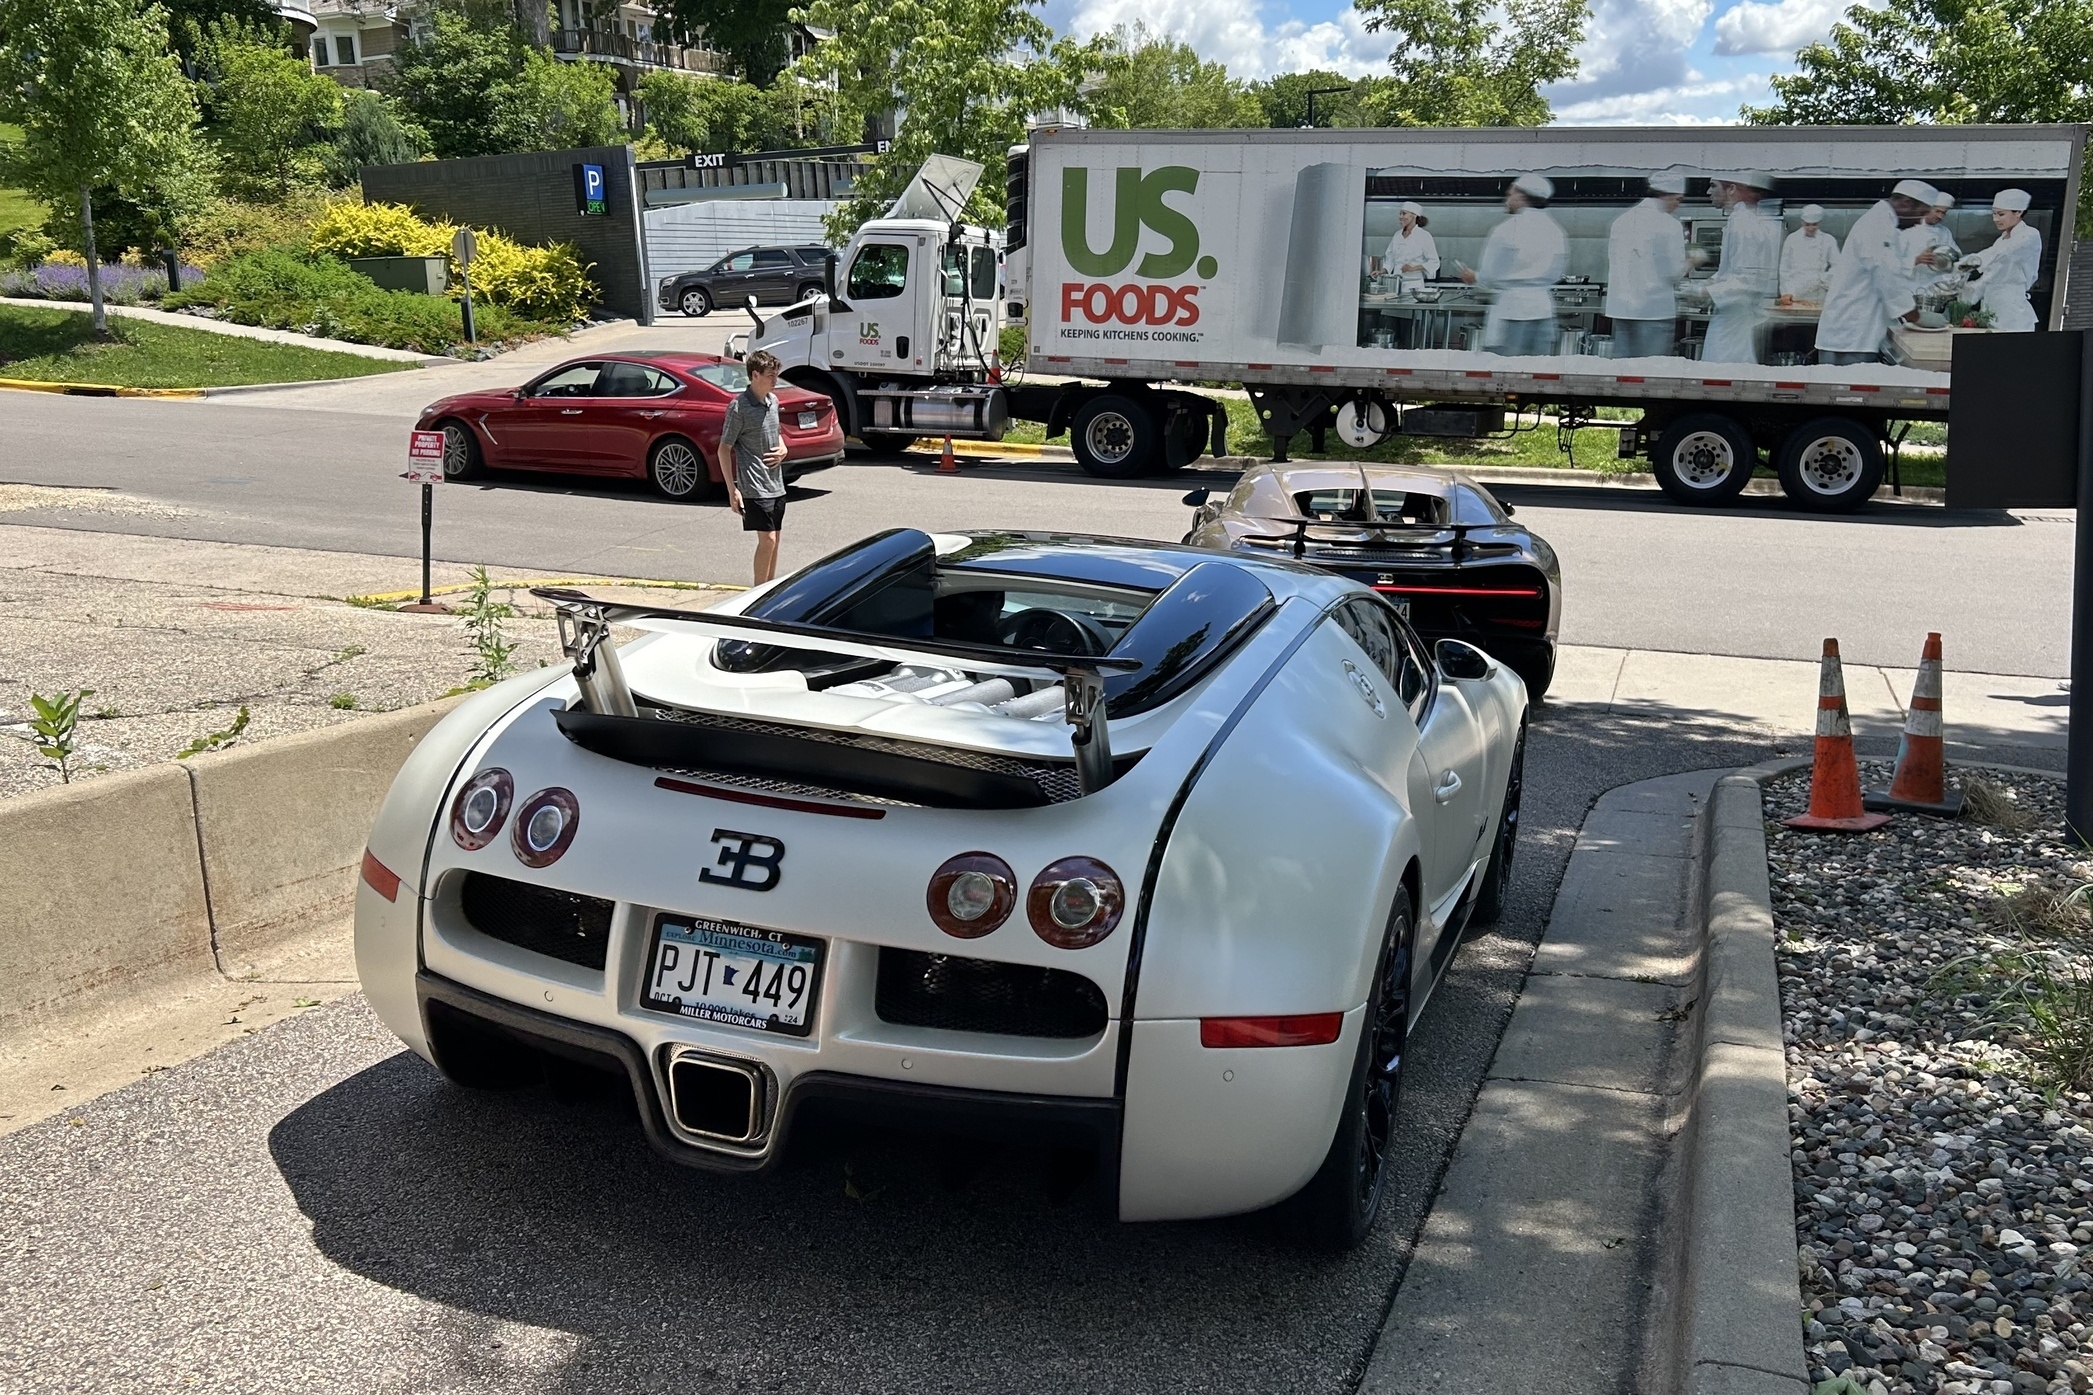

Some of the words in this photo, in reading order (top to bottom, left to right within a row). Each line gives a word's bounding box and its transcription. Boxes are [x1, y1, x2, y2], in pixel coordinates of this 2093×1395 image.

[694, 153, 725, 168] EXIT
[587, 170, 600, 196] P
[588, 202, 605, 213] OPEN
[1061, 166, 1218, 280] US.
[787, 317, 808, 328] 102267
[860, 322, 881, 339] US.
[1060, 329, 1100, 339] KEEPING
[1103, 330, 1149, 341] KITCHENS
[859, 338, 879, 346] FOODS
[666, 931, 696, 942] EXPLORE
[695, 920, 762, 938] GREENWICH,
[768, 932, 783, 942] CT
[699, 930, 797, 958] Minnesota.com
[656, 944, 721, 996] PJT
[742, 959, 807, 1010] 449
[654, 992, 672, 1002] OCT
[679, 1005, 711, 1020] MILLER
[711, 1011, 767, 1030] MOTORCARS
[787, 1015, 798, 1024] 24
